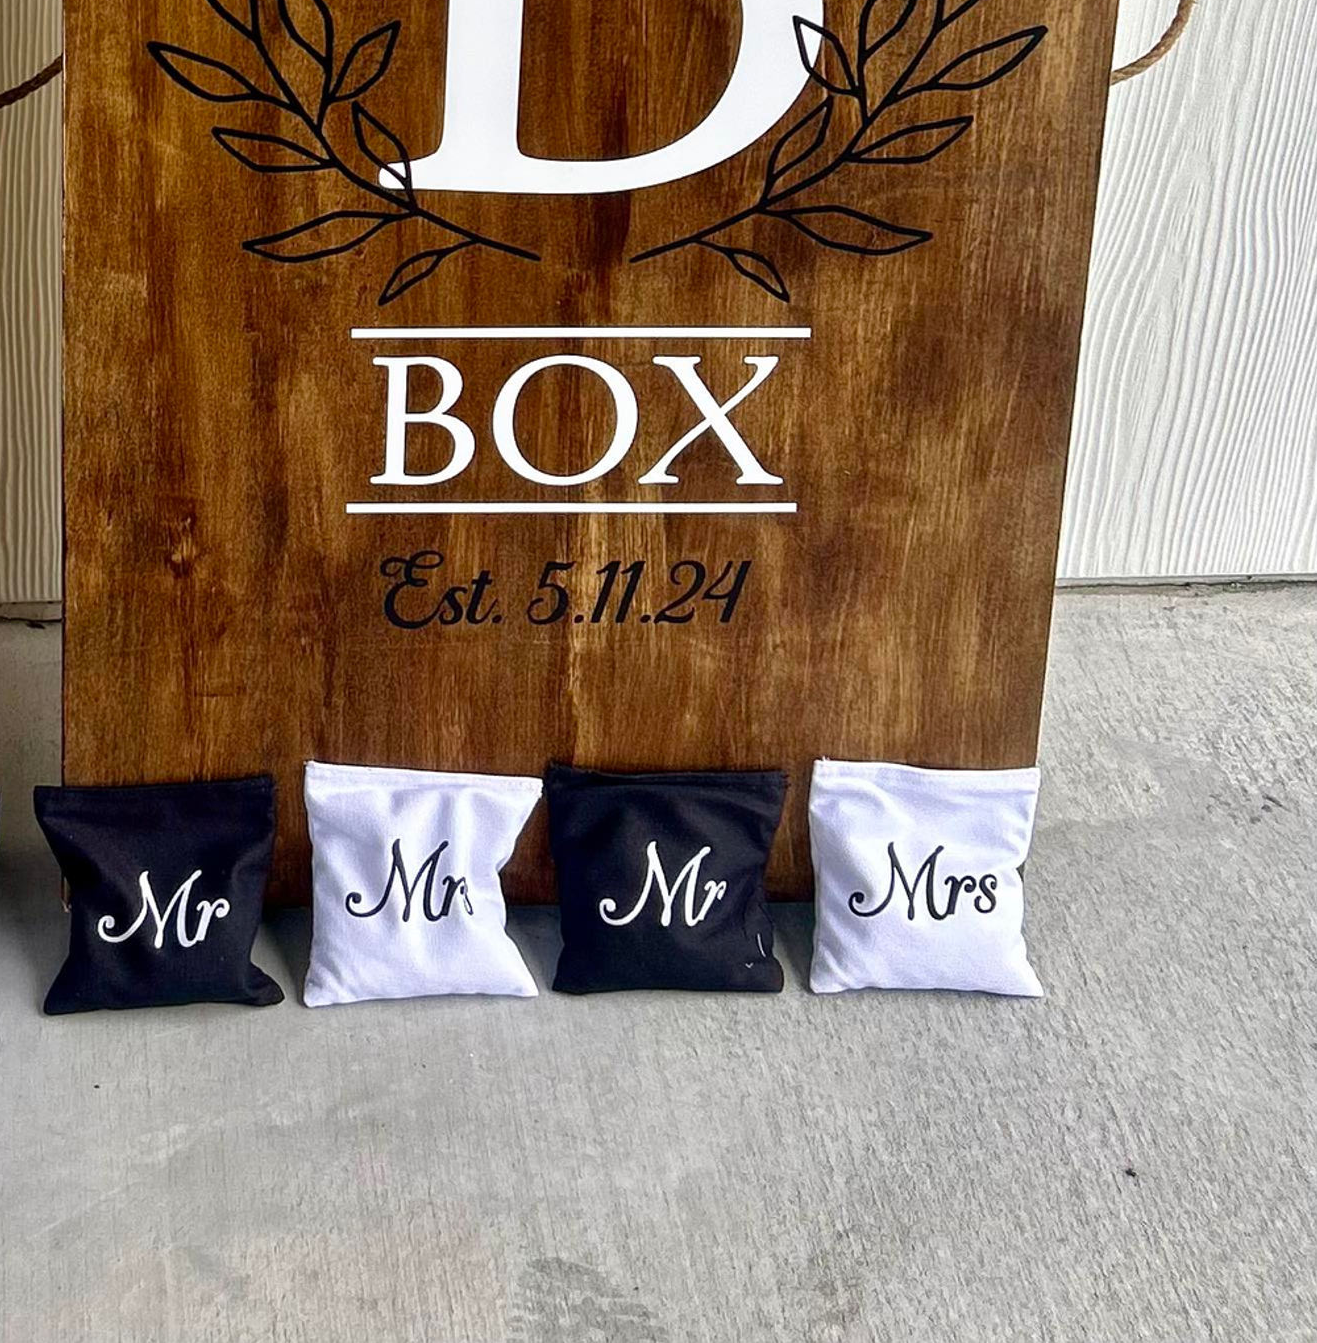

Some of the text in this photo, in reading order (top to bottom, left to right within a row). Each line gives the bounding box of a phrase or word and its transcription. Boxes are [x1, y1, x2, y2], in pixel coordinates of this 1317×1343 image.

[370, 354, 783, 485] BOX
[380, 550, 752, 629] Est. 5.11.24
[97, 869, 231, 949] Mr
[599, 841, 727, 926] Mr
[849, 842, 998, 921] Mrs
